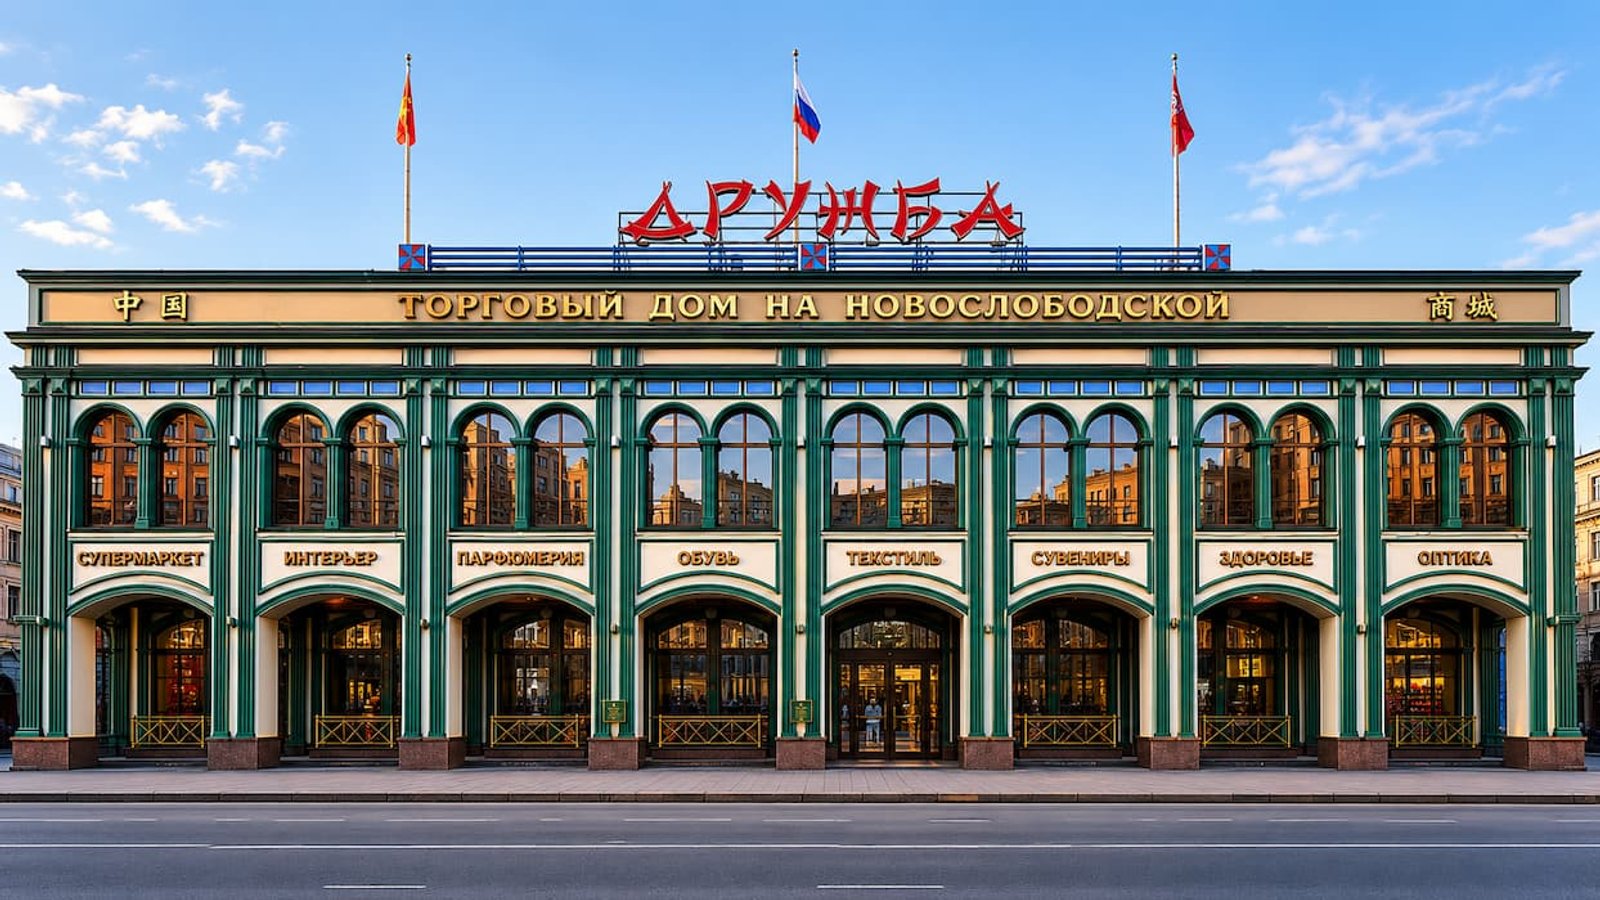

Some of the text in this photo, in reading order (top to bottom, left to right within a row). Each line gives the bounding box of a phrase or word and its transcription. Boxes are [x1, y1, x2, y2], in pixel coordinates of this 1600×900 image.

[618, 177, 1026, 243] ДРУЖБА
[112, 290, 189, 321] 中国
[399, 290, 1231, 322] ТОРГОВЫЙ ДОМ НА НОВОСЛОБОДСКОЙ
[1426, 291, 1499, 321] 商城
[77, 551, 205, 567] СУПЕРМАРКЕТ
[283, 551, 378, 567] ИНТЕРЬЕР
[457, 551, 585, 567] ПАРФЮМЕРИЯ
[677, 551, 740, 567] ОБУВЬ
[846, 551, 942, 567] ТЕКСТИЛЬ
[1031, 551, 1131, 567] СУВЕНИРЫ
[1219, 551, 1314, 568] ЗДОРОВЬЕ
[1417, 551, 1493, 567] ОПТИКА
